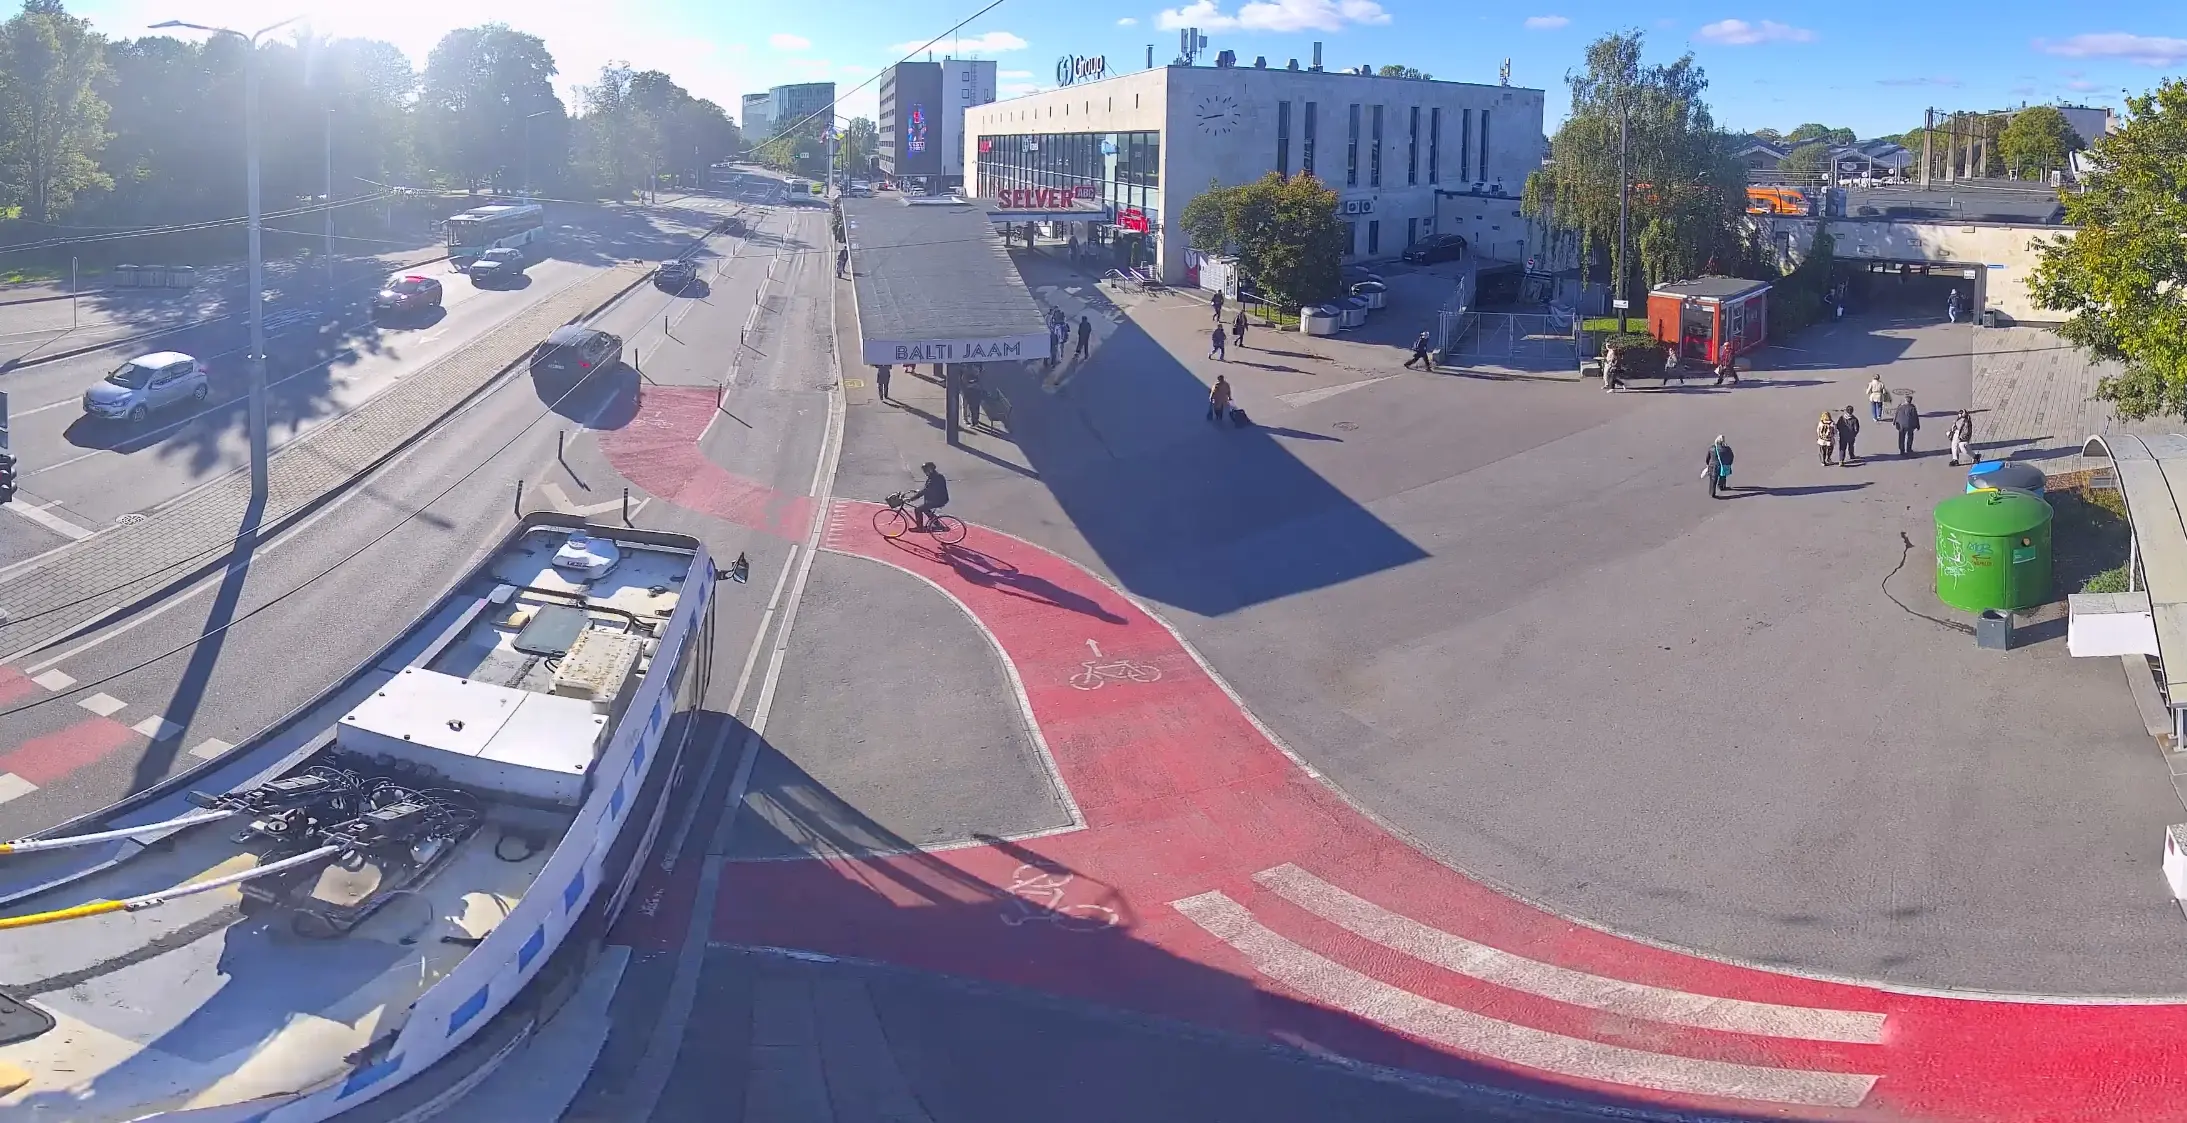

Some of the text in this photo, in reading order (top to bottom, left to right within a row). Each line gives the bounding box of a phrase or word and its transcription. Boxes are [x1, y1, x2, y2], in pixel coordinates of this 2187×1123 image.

[1076, 54, 1105, 79] Group
[998, 187, 1094, 208] SELVER ABC
[895, 341, 1021, 361] BALTI JAAM
